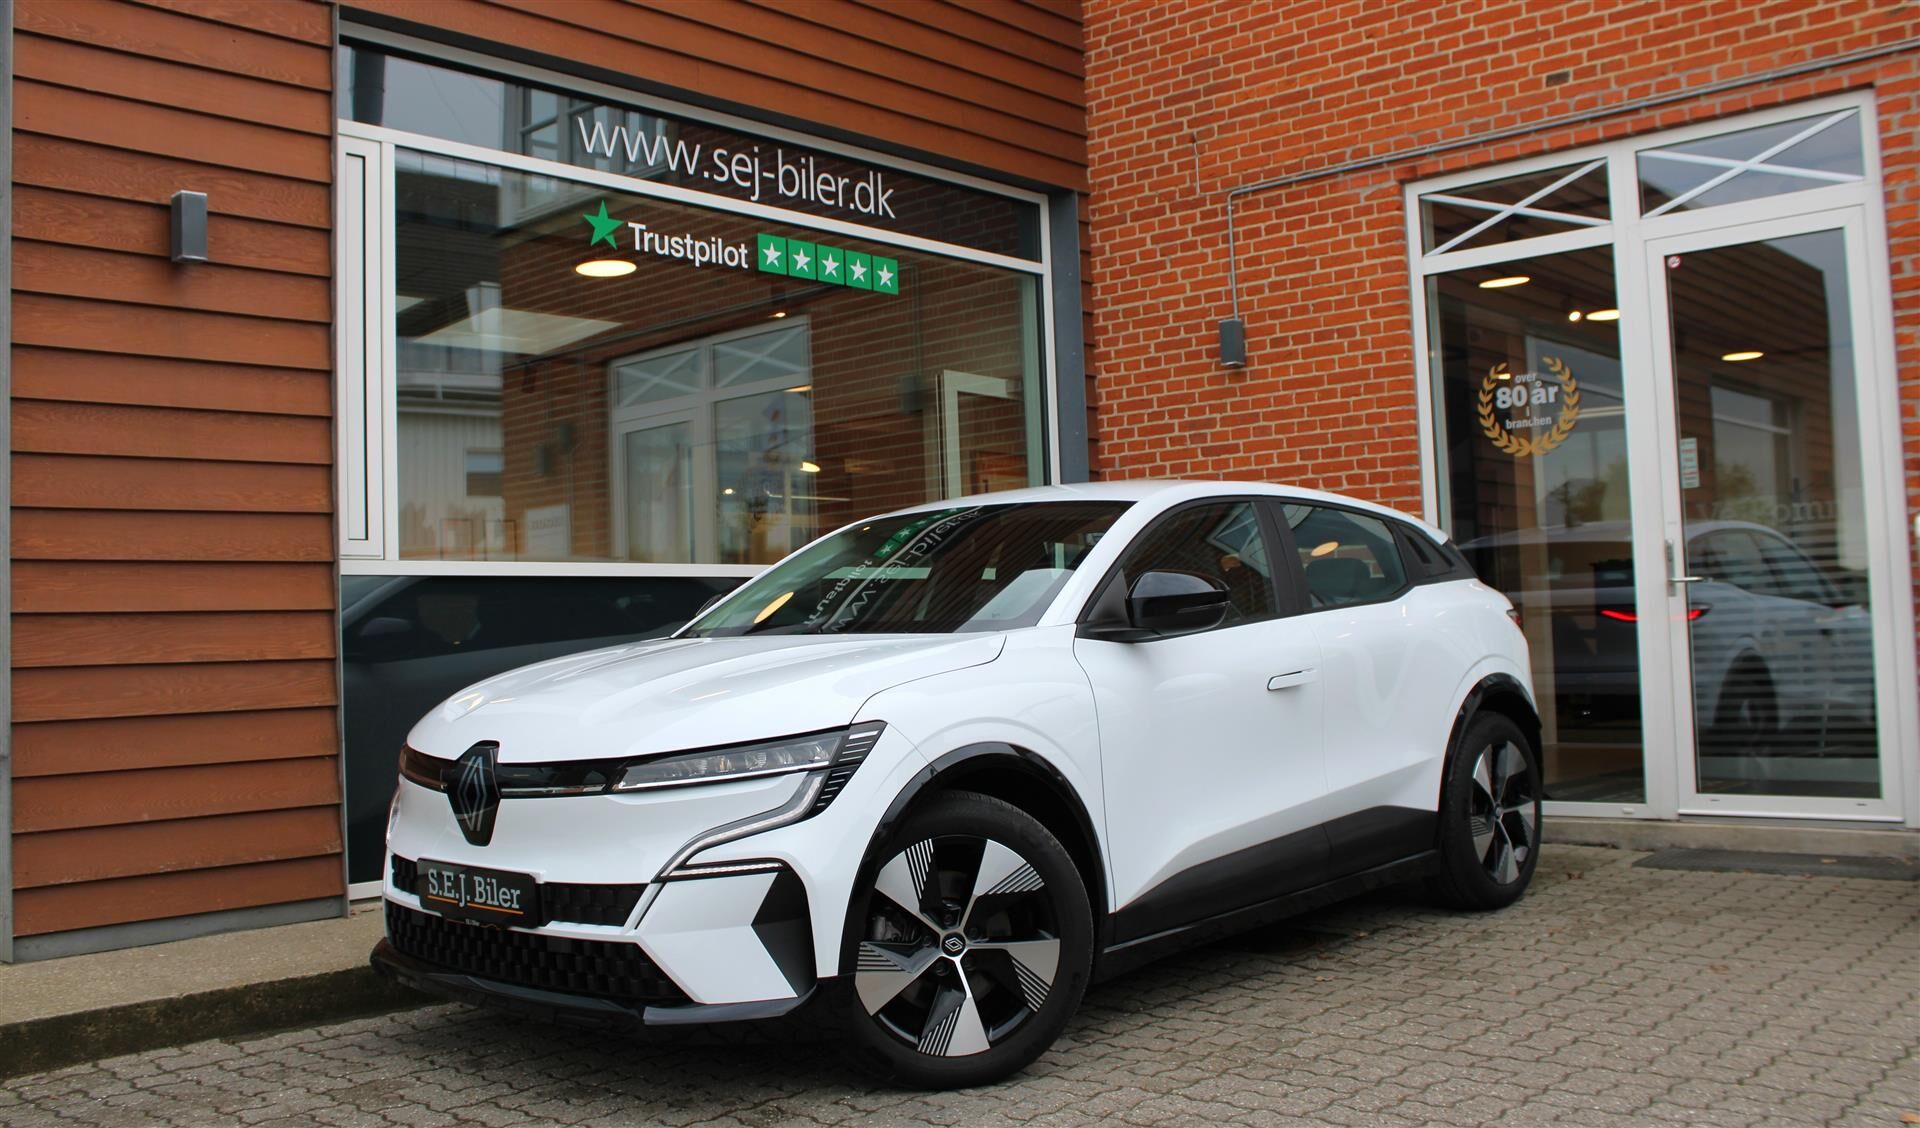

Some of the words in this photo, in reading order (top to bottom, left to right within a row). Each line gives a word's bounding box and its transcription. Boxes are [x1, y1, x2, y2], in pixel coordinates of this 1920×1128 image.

[577, 116, 897, 219] www.sej-biler.dk
[627, 221, 749, 269] Trustpilot
[1496, 385, 1527, 409] 80
[1531, 380, 1558, 404] år
[1515, 373, 1537, 383] over
[1506, 416, 1551, 429] branchen
[427, 868, 471, 908] S.E.J.
[473, 875, 521, 909] Biler
